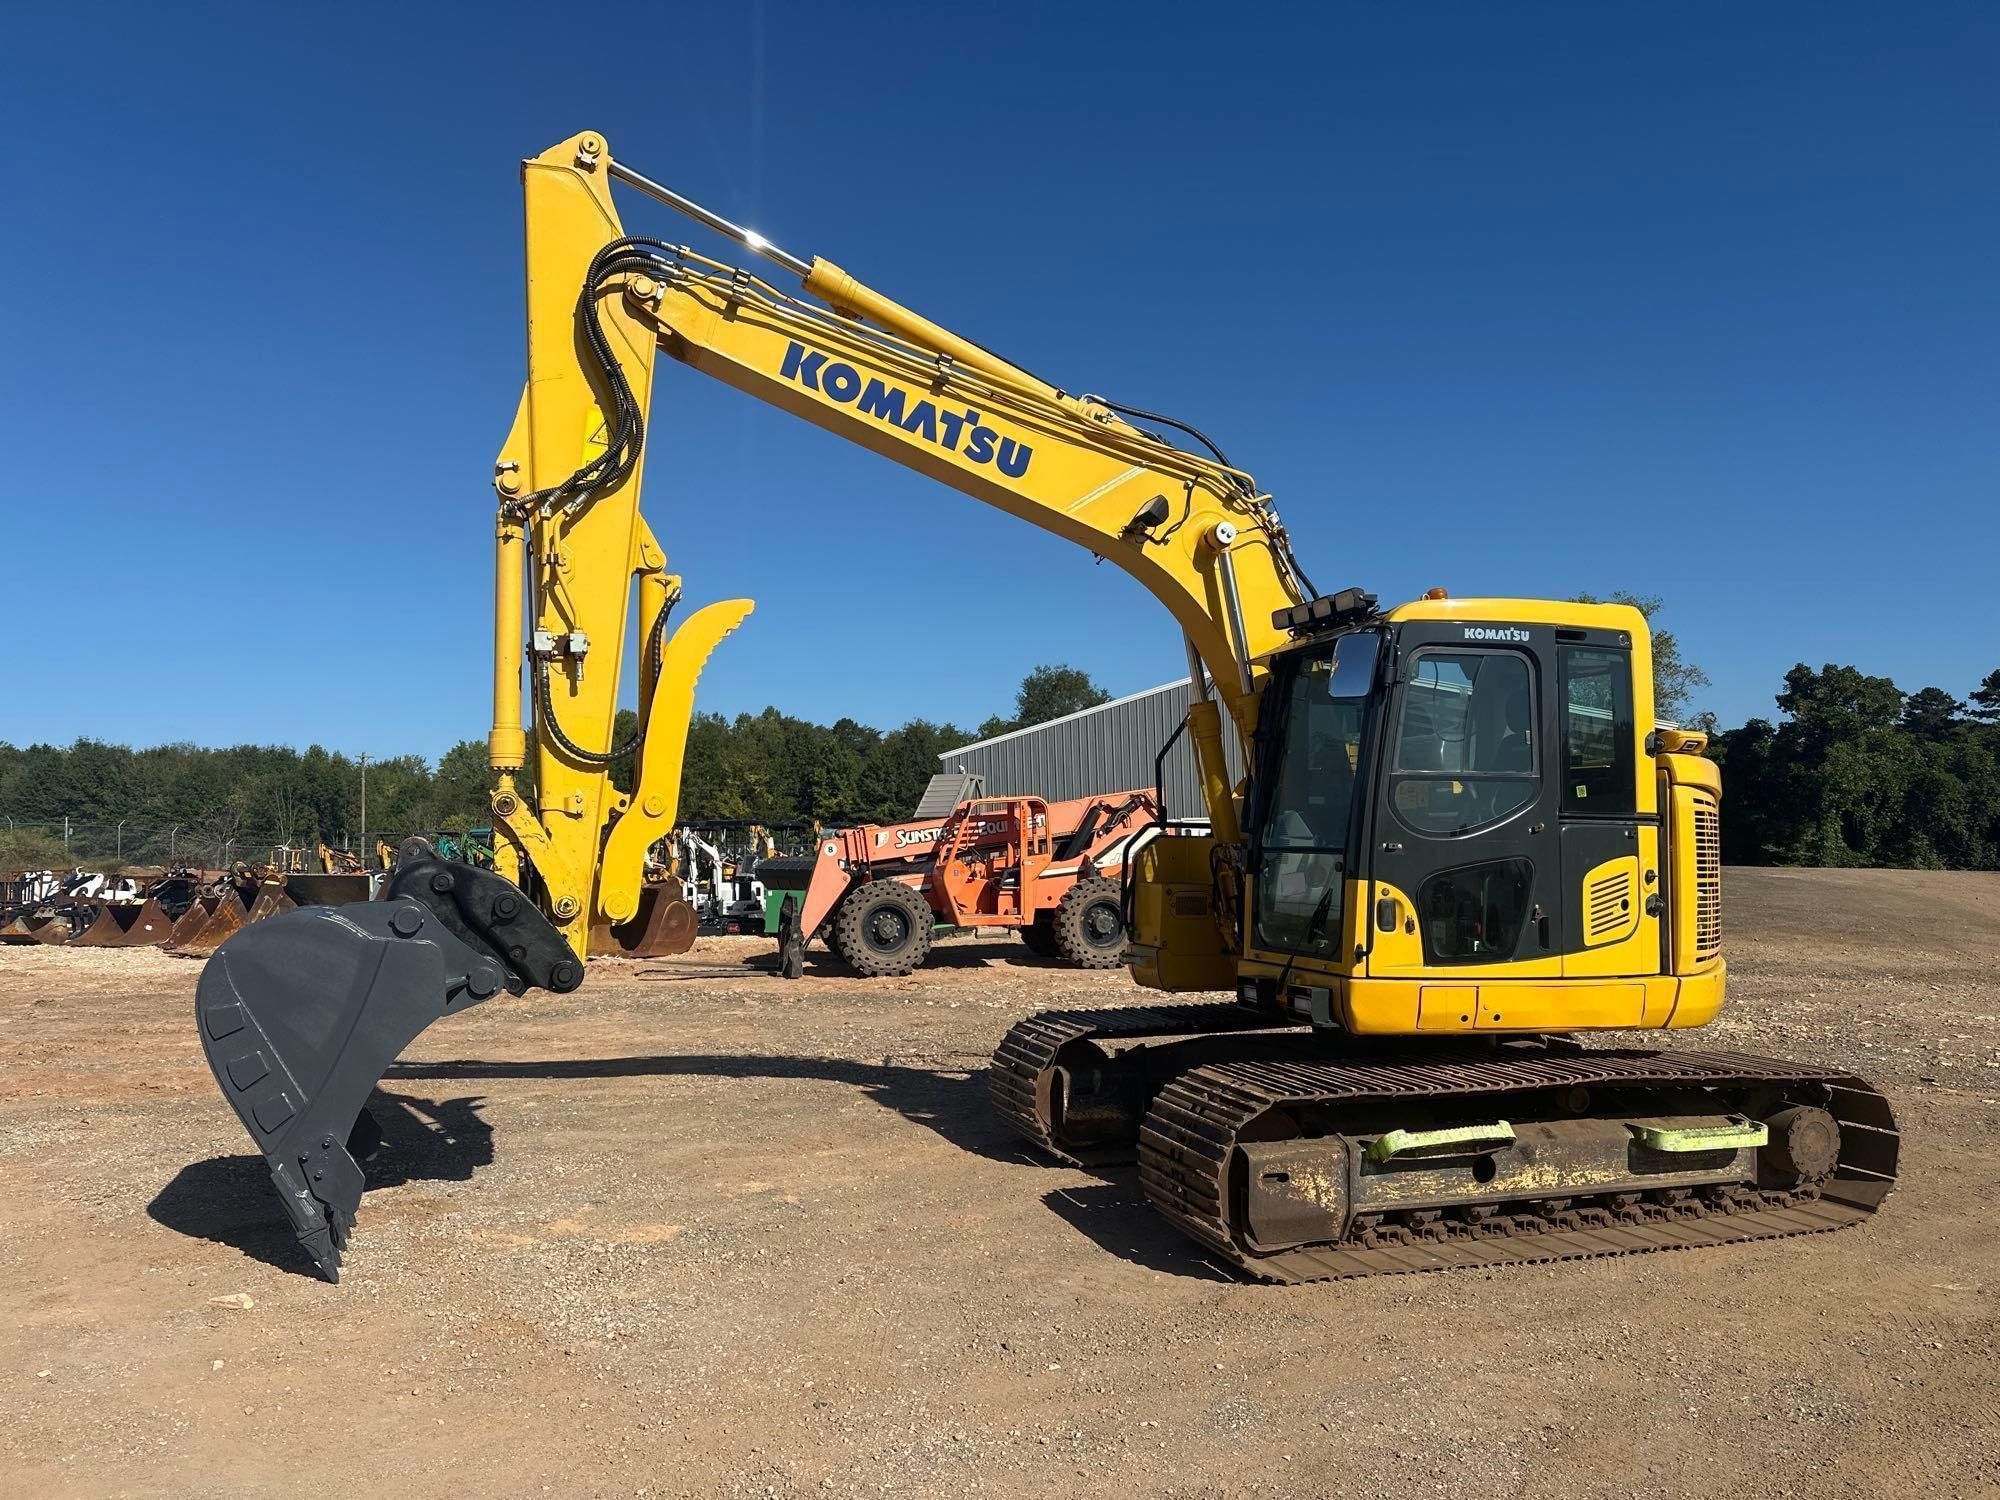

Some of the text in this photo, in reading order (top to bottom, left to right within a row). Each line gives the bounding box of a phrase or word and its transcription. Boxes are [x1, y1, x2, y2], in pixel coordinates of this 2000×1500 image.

[780, 341, 1033, 478] KOMATSU
[1464, 627, 1530, 642] KOMATSU
[895, 822, 976, 848] SUNSTA
